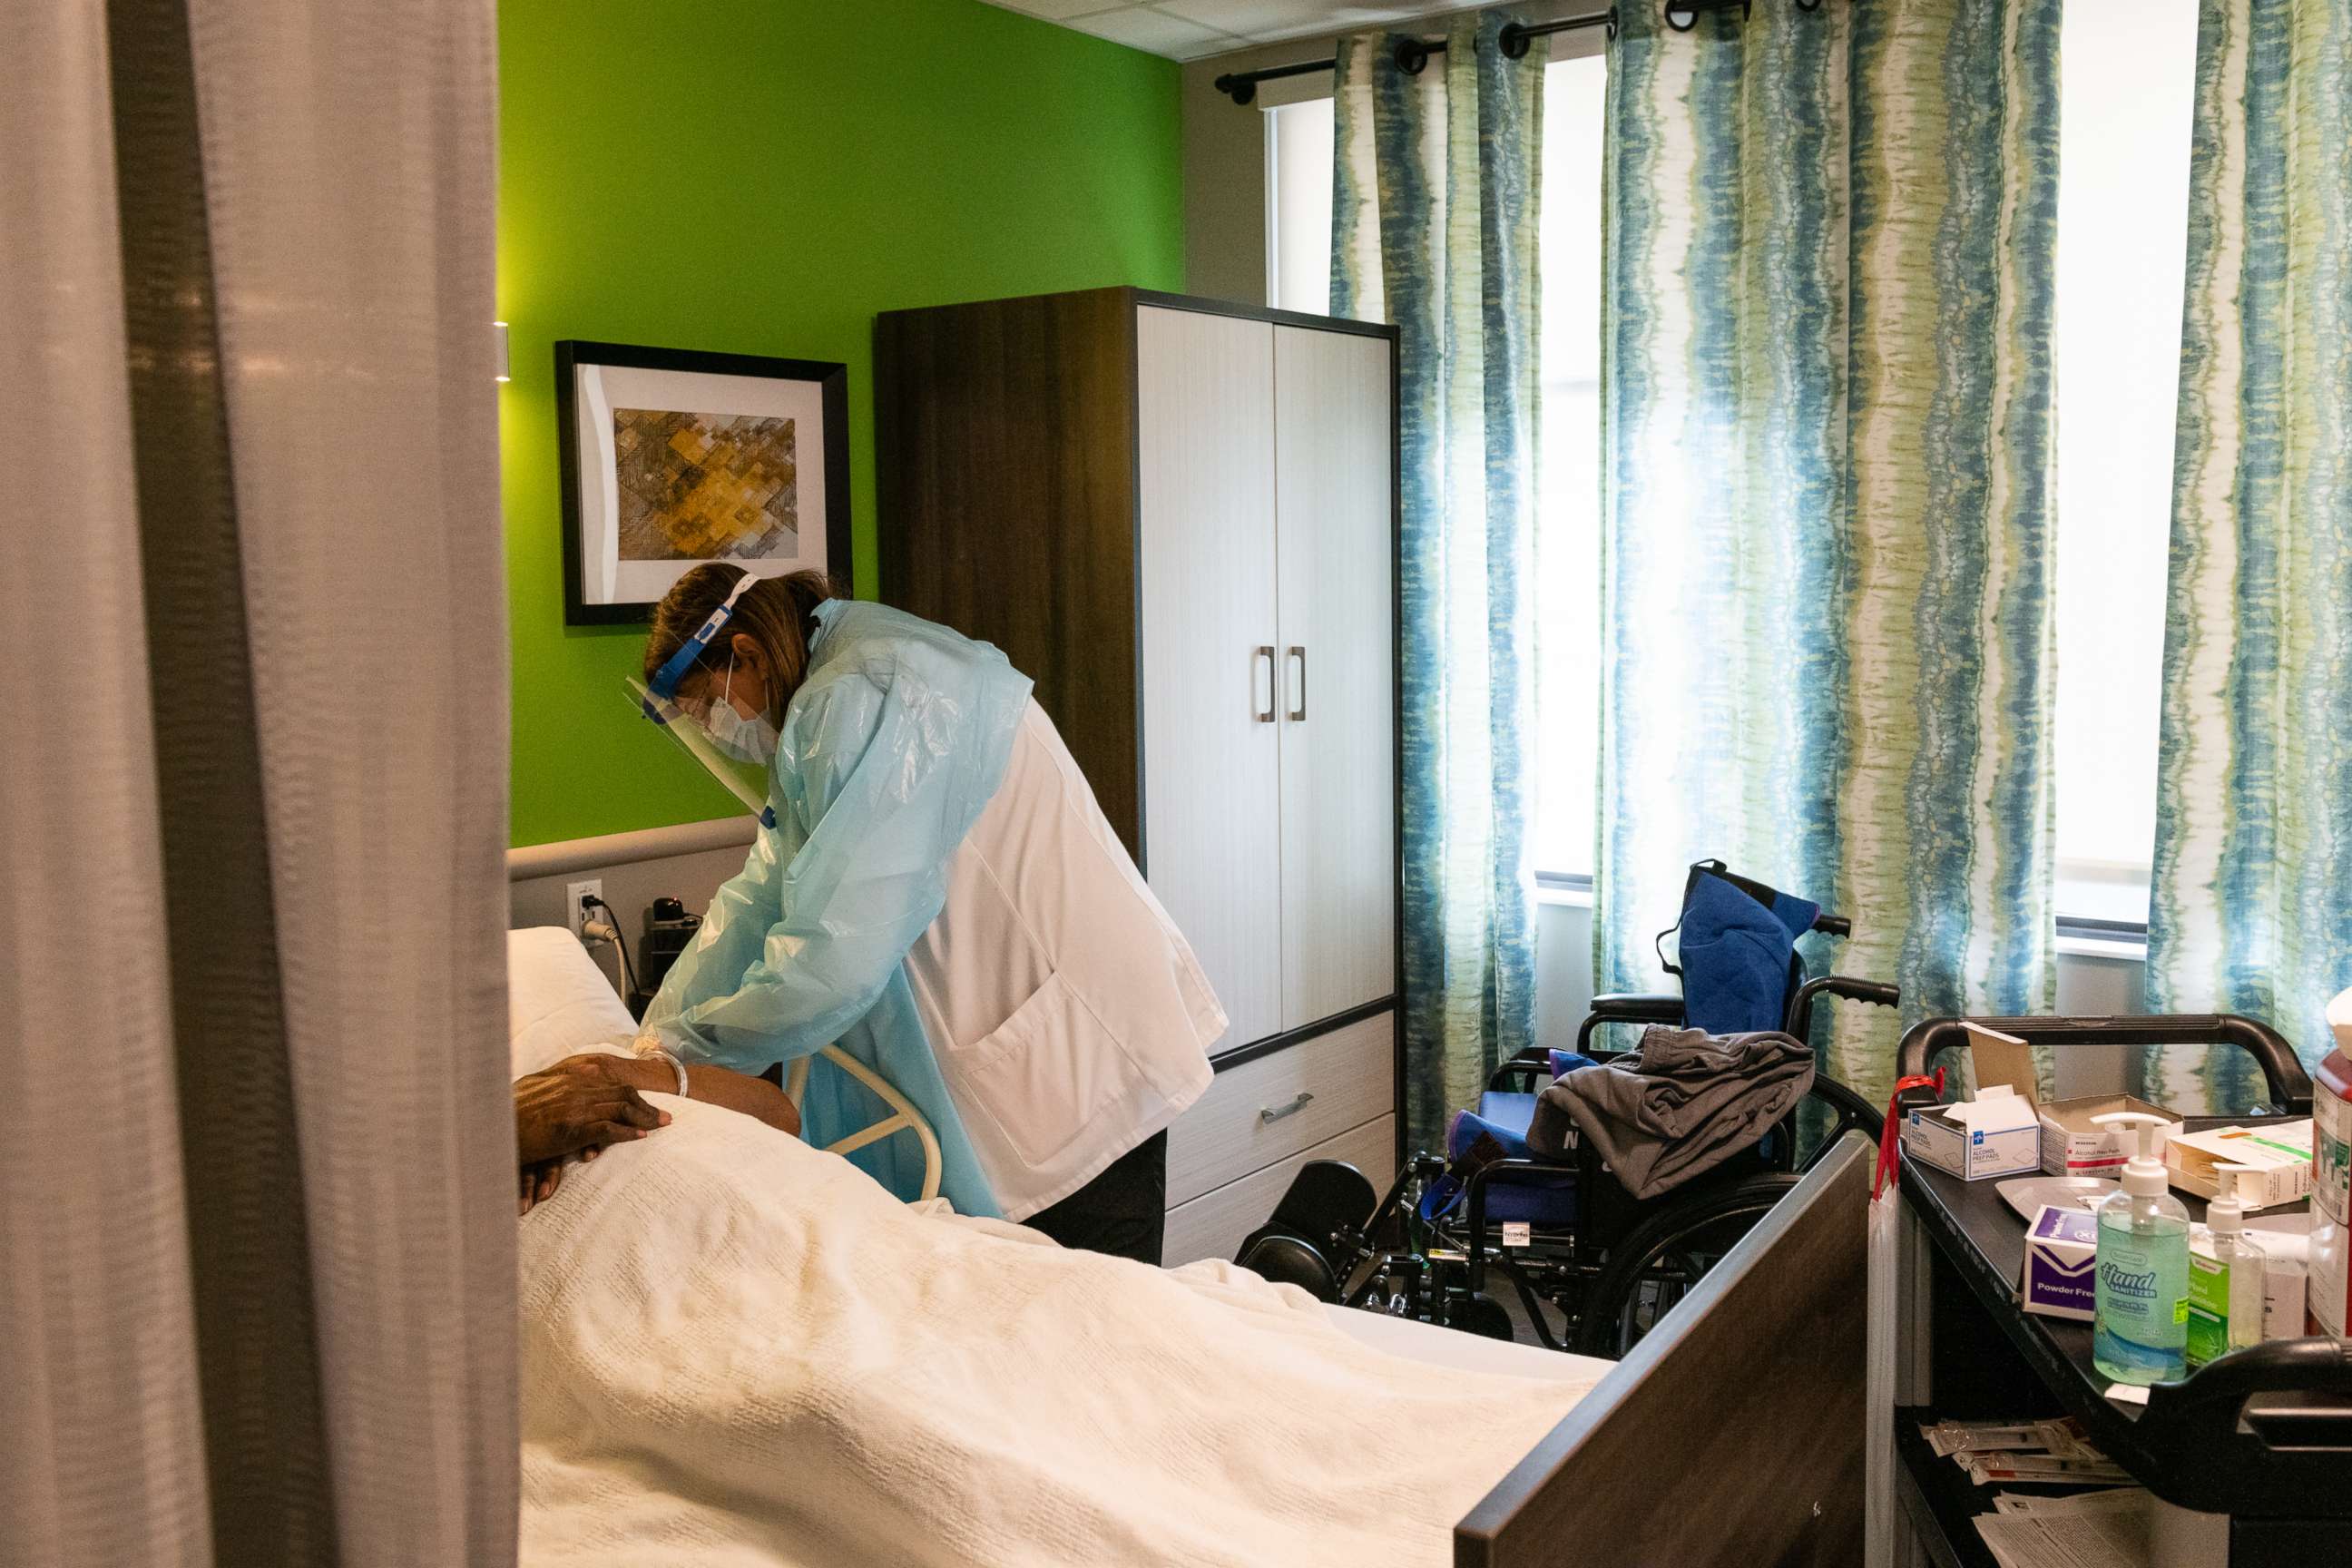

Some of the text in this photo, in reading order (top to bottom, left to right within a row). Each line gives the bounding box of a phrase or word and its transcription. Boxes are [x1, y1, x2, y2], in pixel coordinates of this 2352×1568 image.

[2102, 1262, 2156, 1289] Hand
[2037, 1282, 2074, 1295] Powder
[2111, 1284, 2156, 1298] SANITIZER
